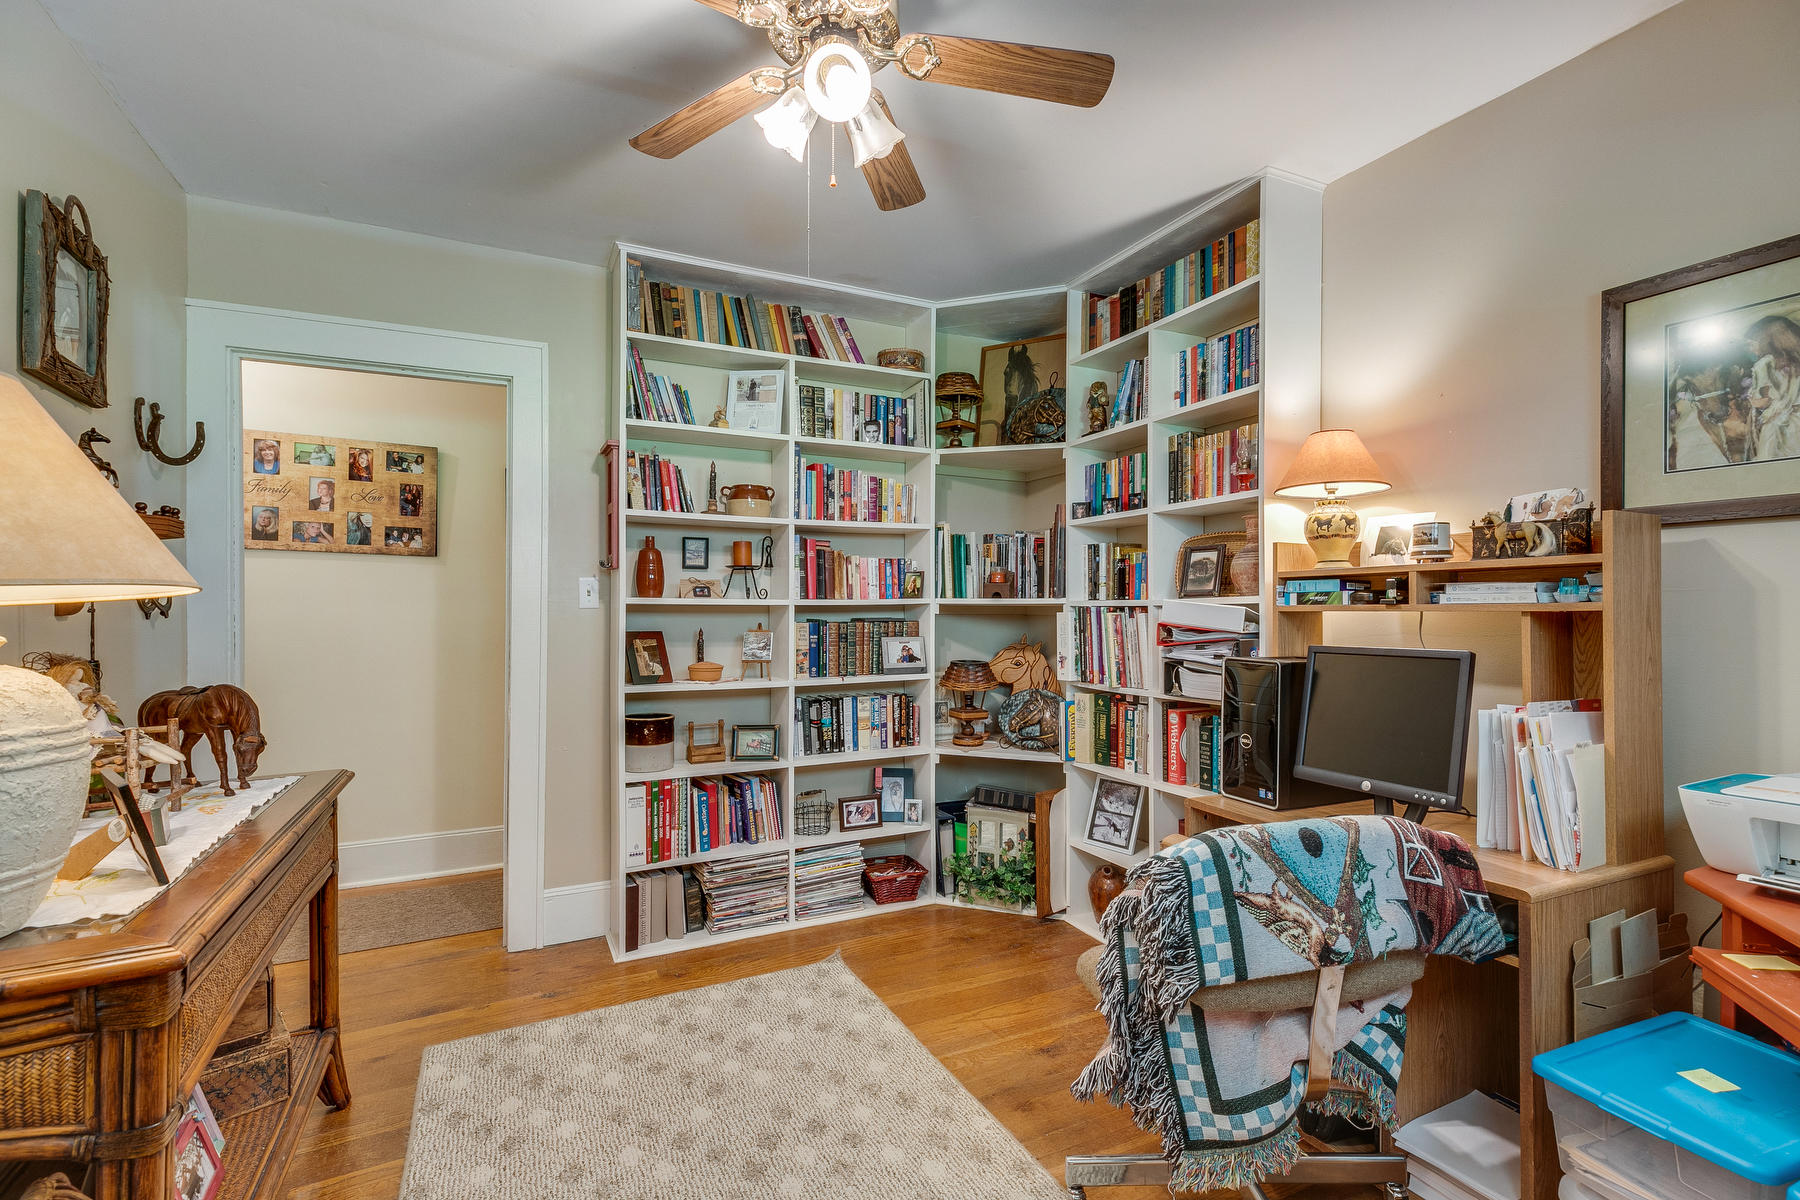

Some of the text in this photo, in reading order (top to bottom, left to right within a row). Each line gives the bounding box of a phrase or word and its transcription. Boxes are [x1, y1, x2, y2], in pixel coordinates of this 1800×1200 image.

[245, 478, 295, 502] Family
[350, 488, 385, 505] Love
[1170, 724, 1179, 771] Webster's
